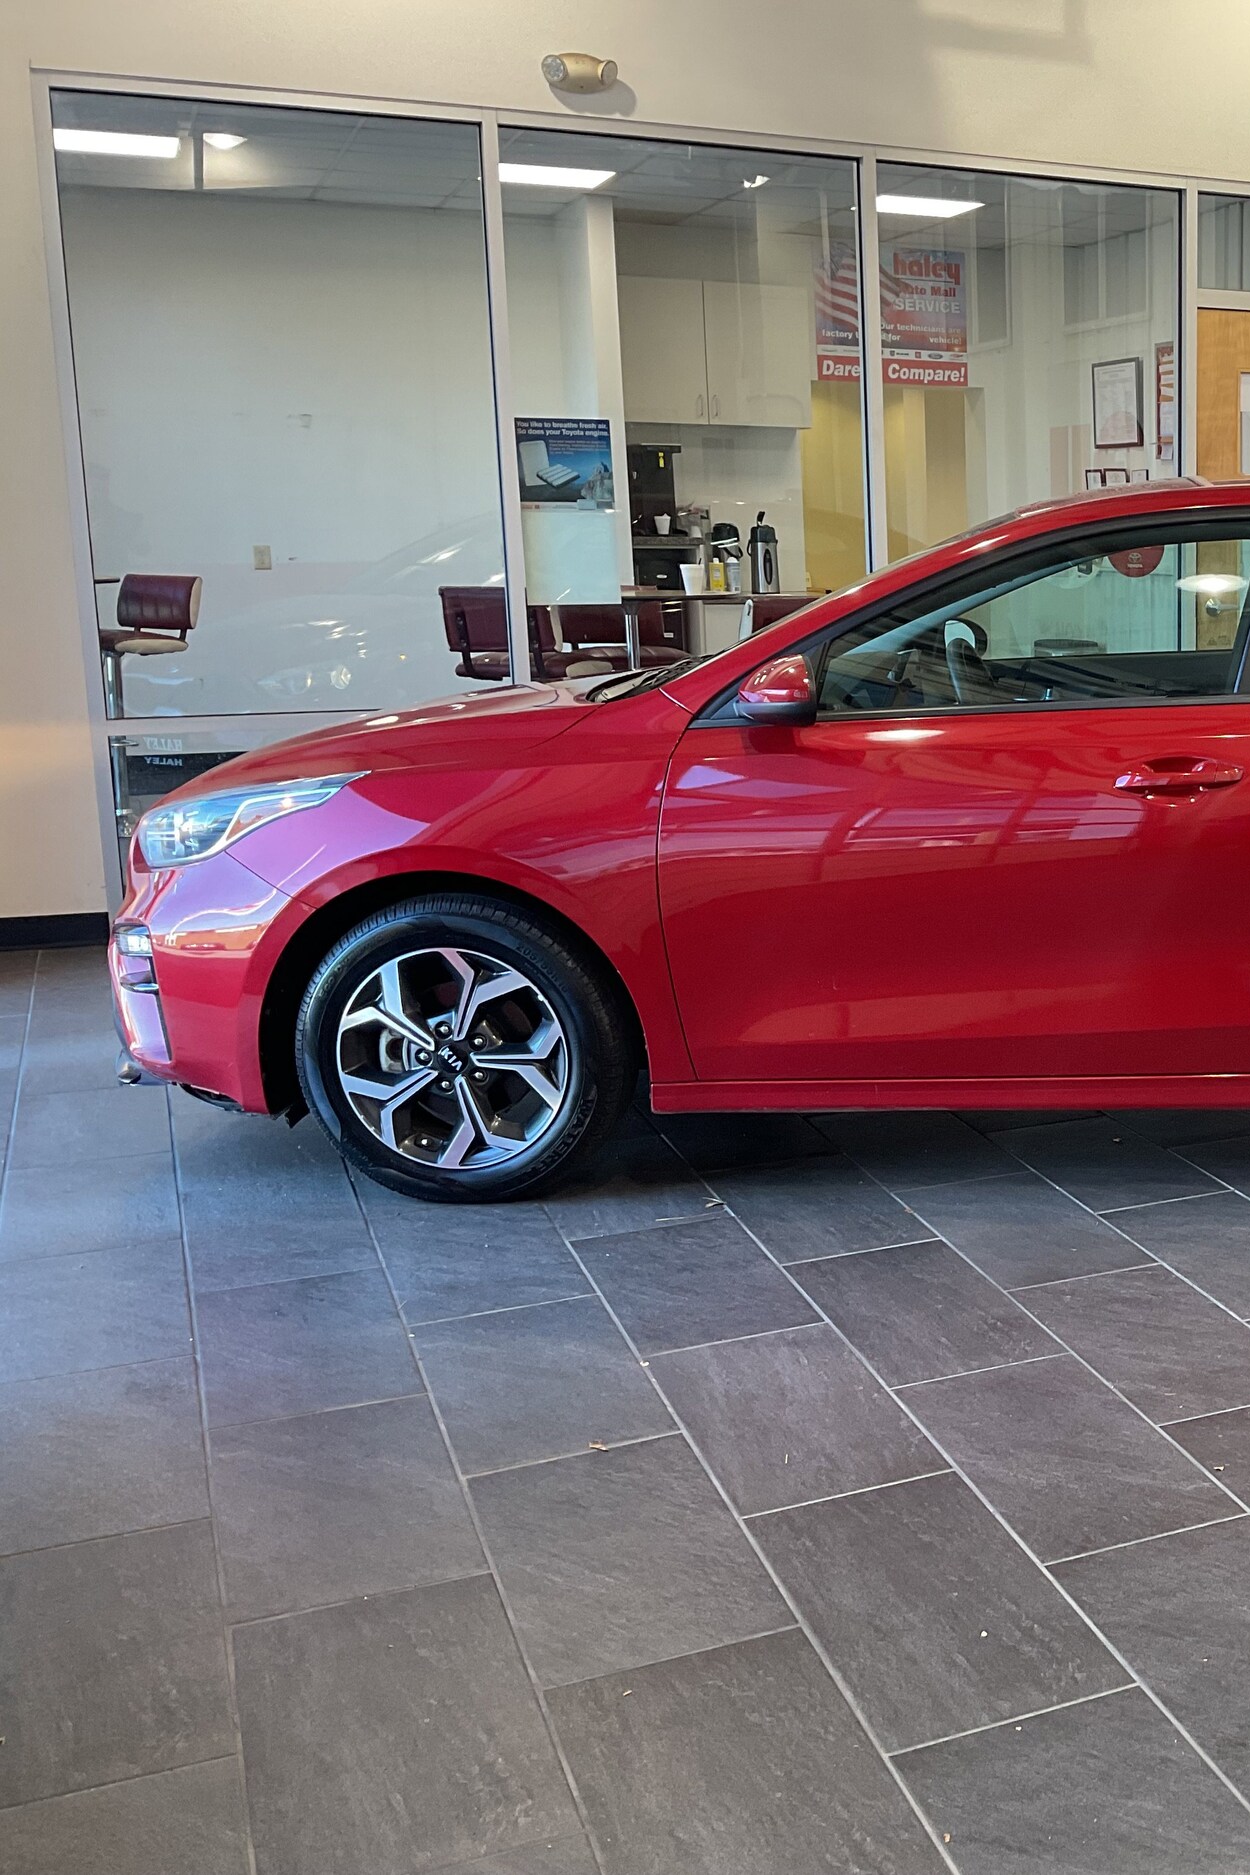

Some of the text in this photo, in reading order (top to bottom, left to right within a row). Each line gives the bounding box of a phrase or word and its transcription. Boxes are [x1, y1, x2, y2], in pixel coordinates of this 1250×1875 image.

[893, 253, 960, 285] haley
[931, 286, 956, 298] Mall
[895, 298, 961, 314] SERVICE
[822, 329, 853, 341] factory
[889, 333, 900, 341] for
[897, 323, 946, 333] technicians
[822, 360, 965, 383] Dare Compare!
[562, 429, 584, 437] Toyota
[440, 1046, 463, 1071] KIA
